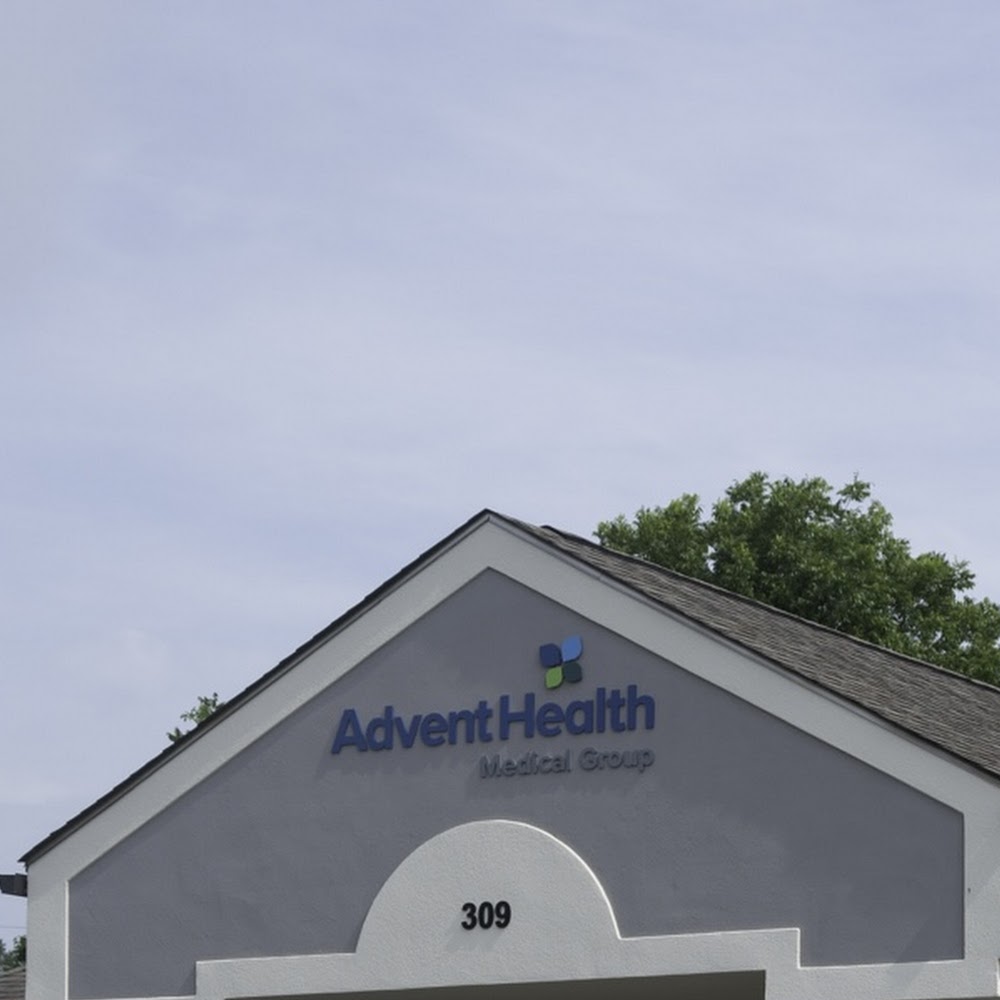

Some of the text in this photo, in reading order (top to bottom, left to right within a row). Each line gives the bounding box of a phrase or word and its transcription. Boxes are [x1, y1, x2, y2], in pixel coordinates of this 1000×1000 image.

[331, 684, 655, 754] AdventHealth
[479, 747, 655, 778] Medical Group
[461, 900, 511, 930] 309
